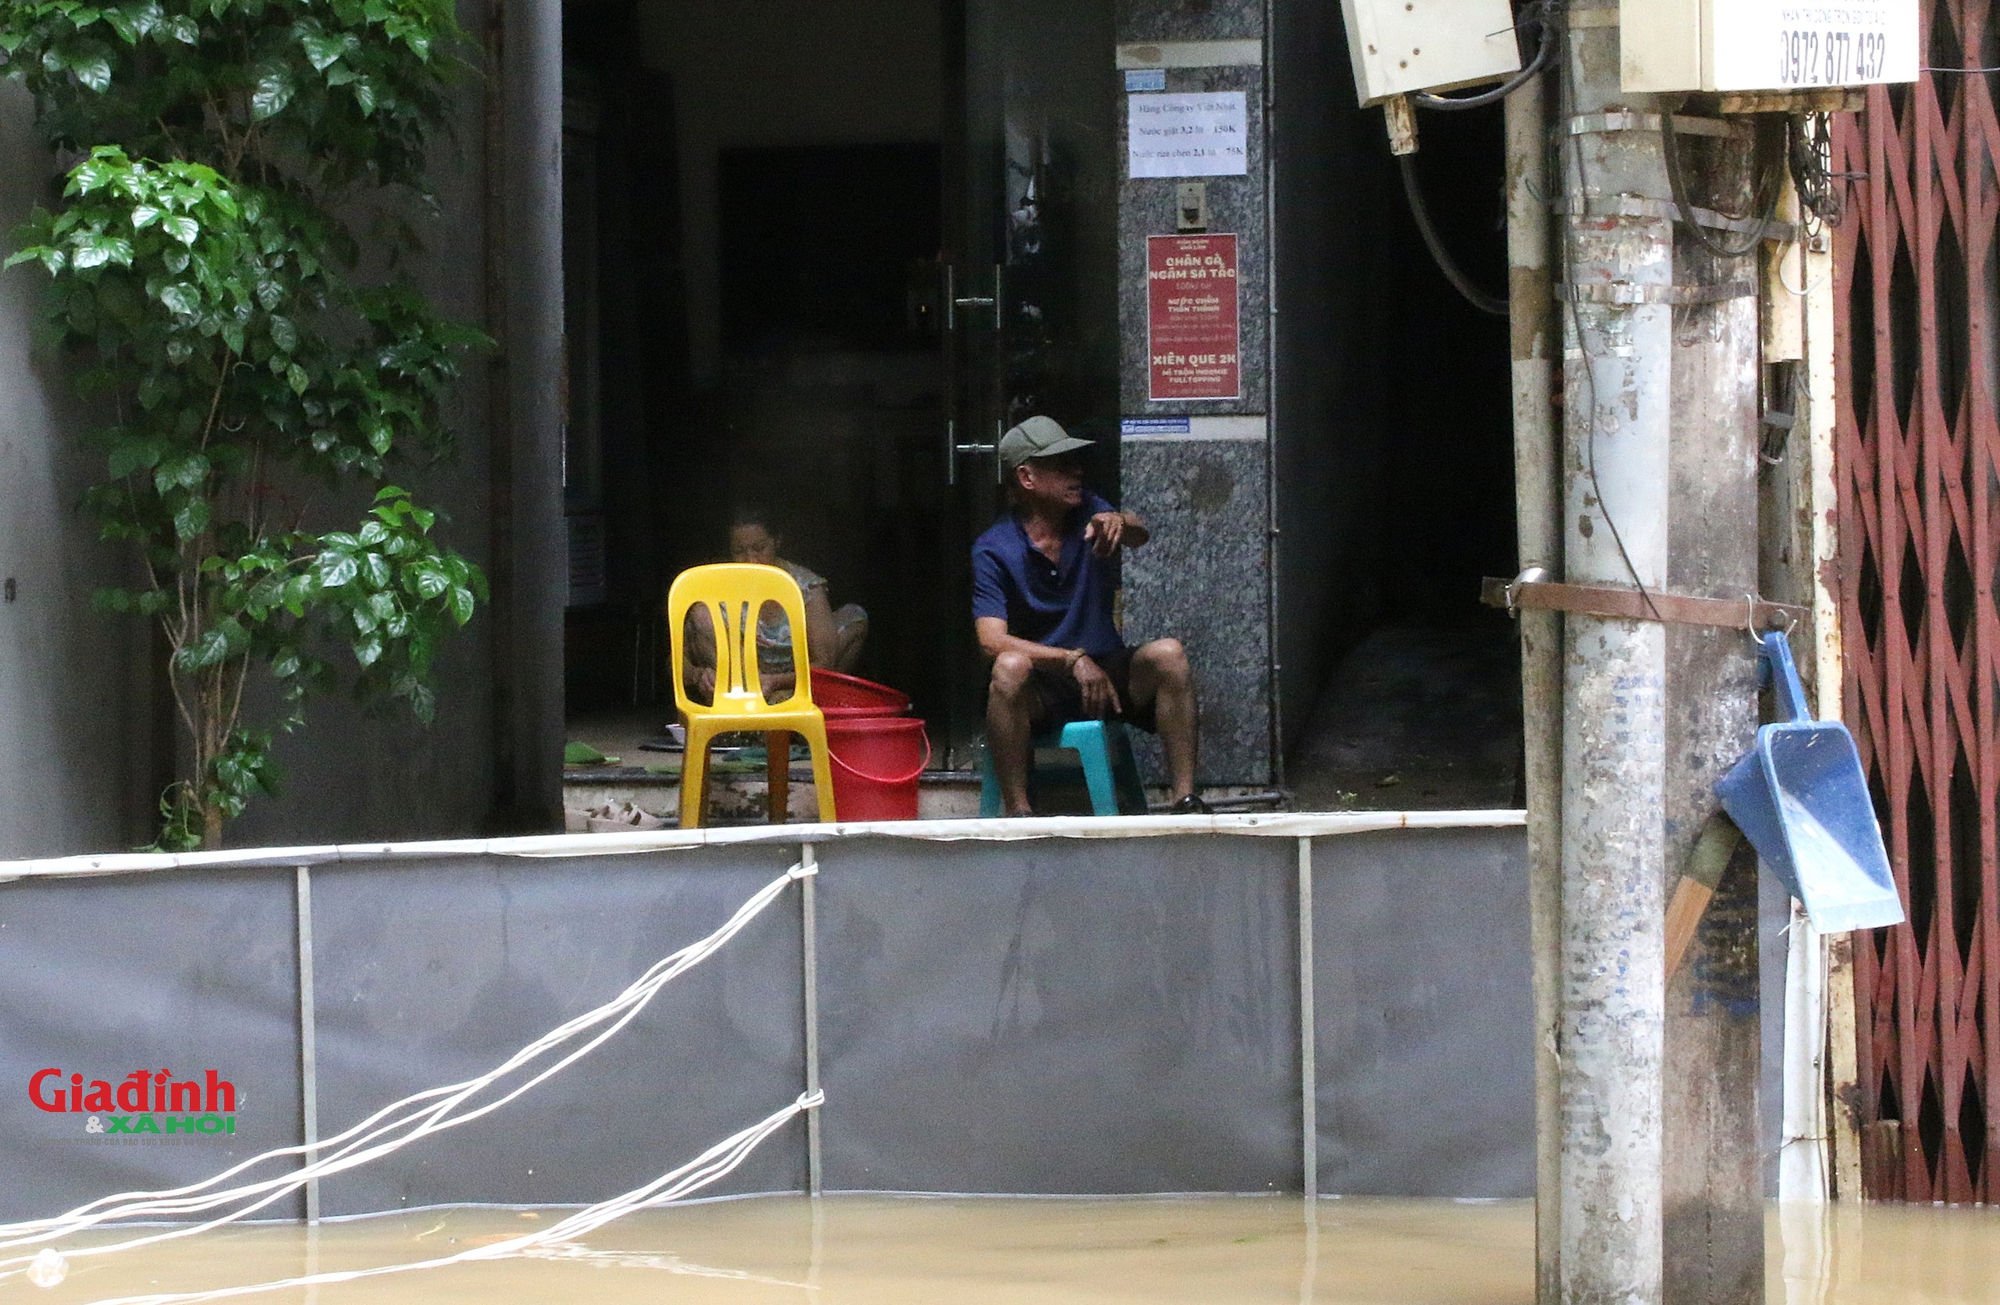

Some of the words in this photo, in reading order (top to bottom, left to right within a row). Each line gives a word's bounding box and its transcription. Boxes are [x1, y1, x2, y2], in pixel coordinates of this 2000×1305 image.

[1780, 30, 1818, 83] 0972
[1825, 31, 1850, 84] 877
[1856, 32, 1885, 80] 432
[1214, 124, 1236, 134] 150K
[1226, 146, 1244, 155] 75K
[1166, 253, 1202, 266] CHÂN
[1205, 251, 1223, 266] GÀ
[1149, 266, 1187, 280] NGÂM
[1153, 351, 1185, 366] XIÊN
[1188, 354, 1216, 367] QUE
[1219, 354, 1237, 364] 2K
